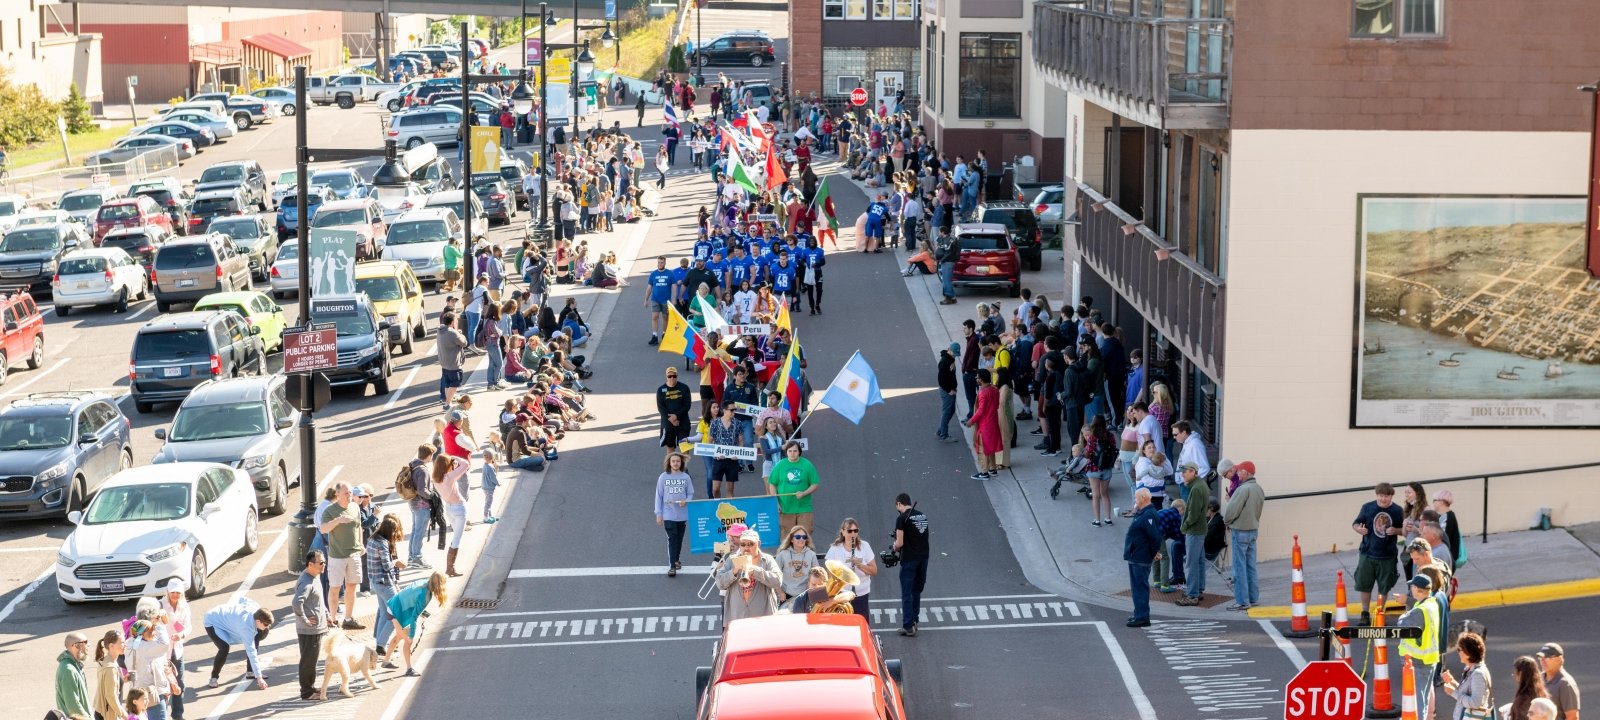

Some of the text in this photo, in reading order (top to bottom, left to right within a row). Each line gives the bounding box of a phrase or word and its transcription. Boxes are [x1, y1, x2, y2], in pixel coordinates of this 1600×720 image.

[872, 204, 884, 216] 55
[322, 236, 345, 244] PLAY
[734, 267, 745, 279] 77
[777, 275, 788, 287] 48
[316, 304, 354, 312] HOUGHTON
[744, 300, 750, 312] 2
[743, 325, 762, 333] Peru
[300, 334, 320, 344] LOT 2
[285, 343, 336, 357] PUBLIC PARKING
[716, 446, 755, 458] Argentina
[720, 517, 746, 526] SOUTH
[1358, 628, 1401, 639] HURON ST
[1289, 687, 1362, 717] STOP
